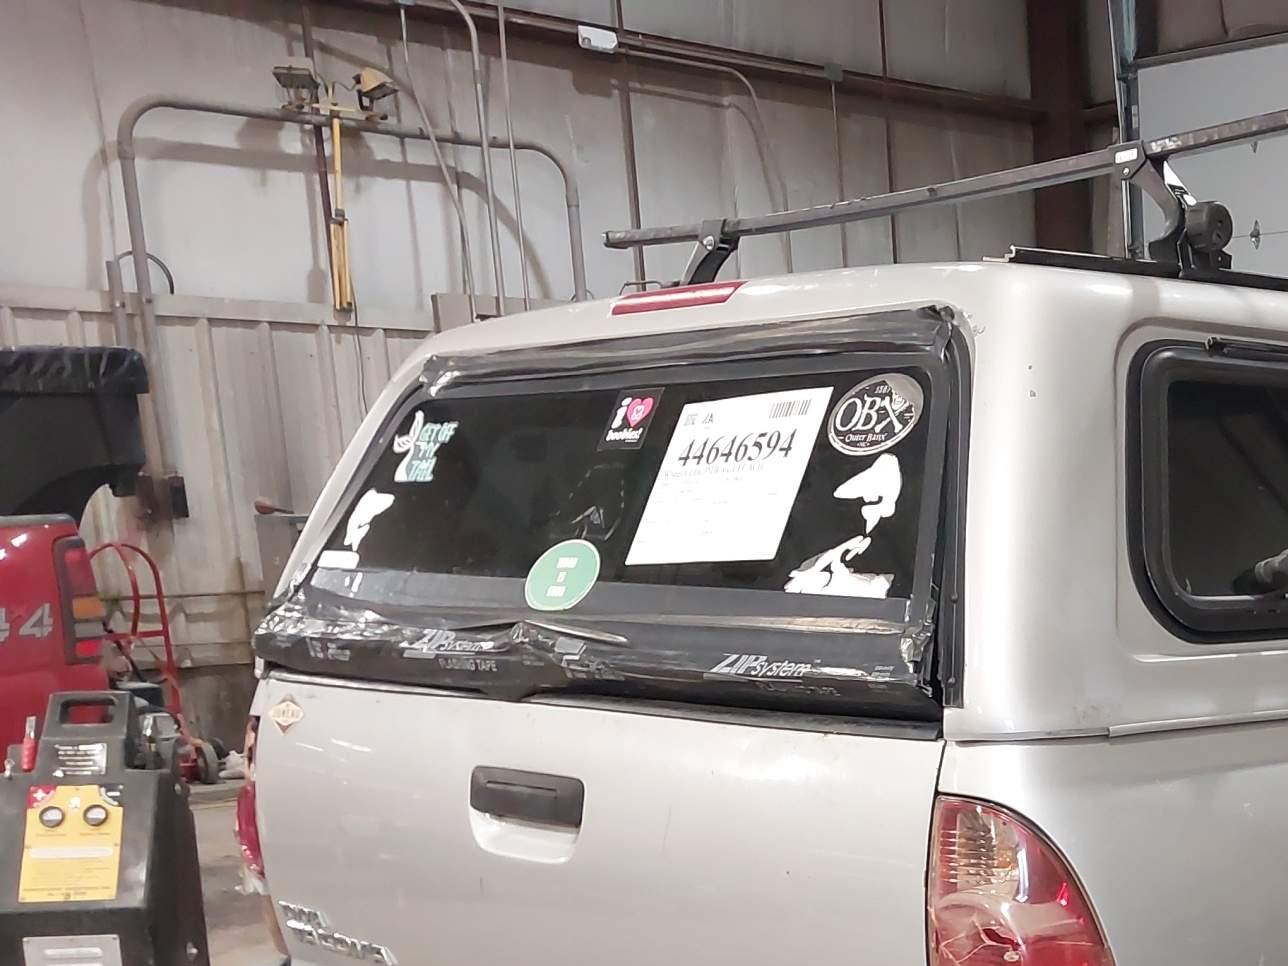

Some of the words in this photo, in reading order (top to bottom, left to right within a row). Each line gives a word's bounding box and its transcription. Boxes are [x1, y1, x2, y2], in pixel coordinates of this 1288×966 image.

[419, 422, 442, 441] GET
[835, 393, 904, 433] OBX
[678, 428, 798, 467] 44646594
